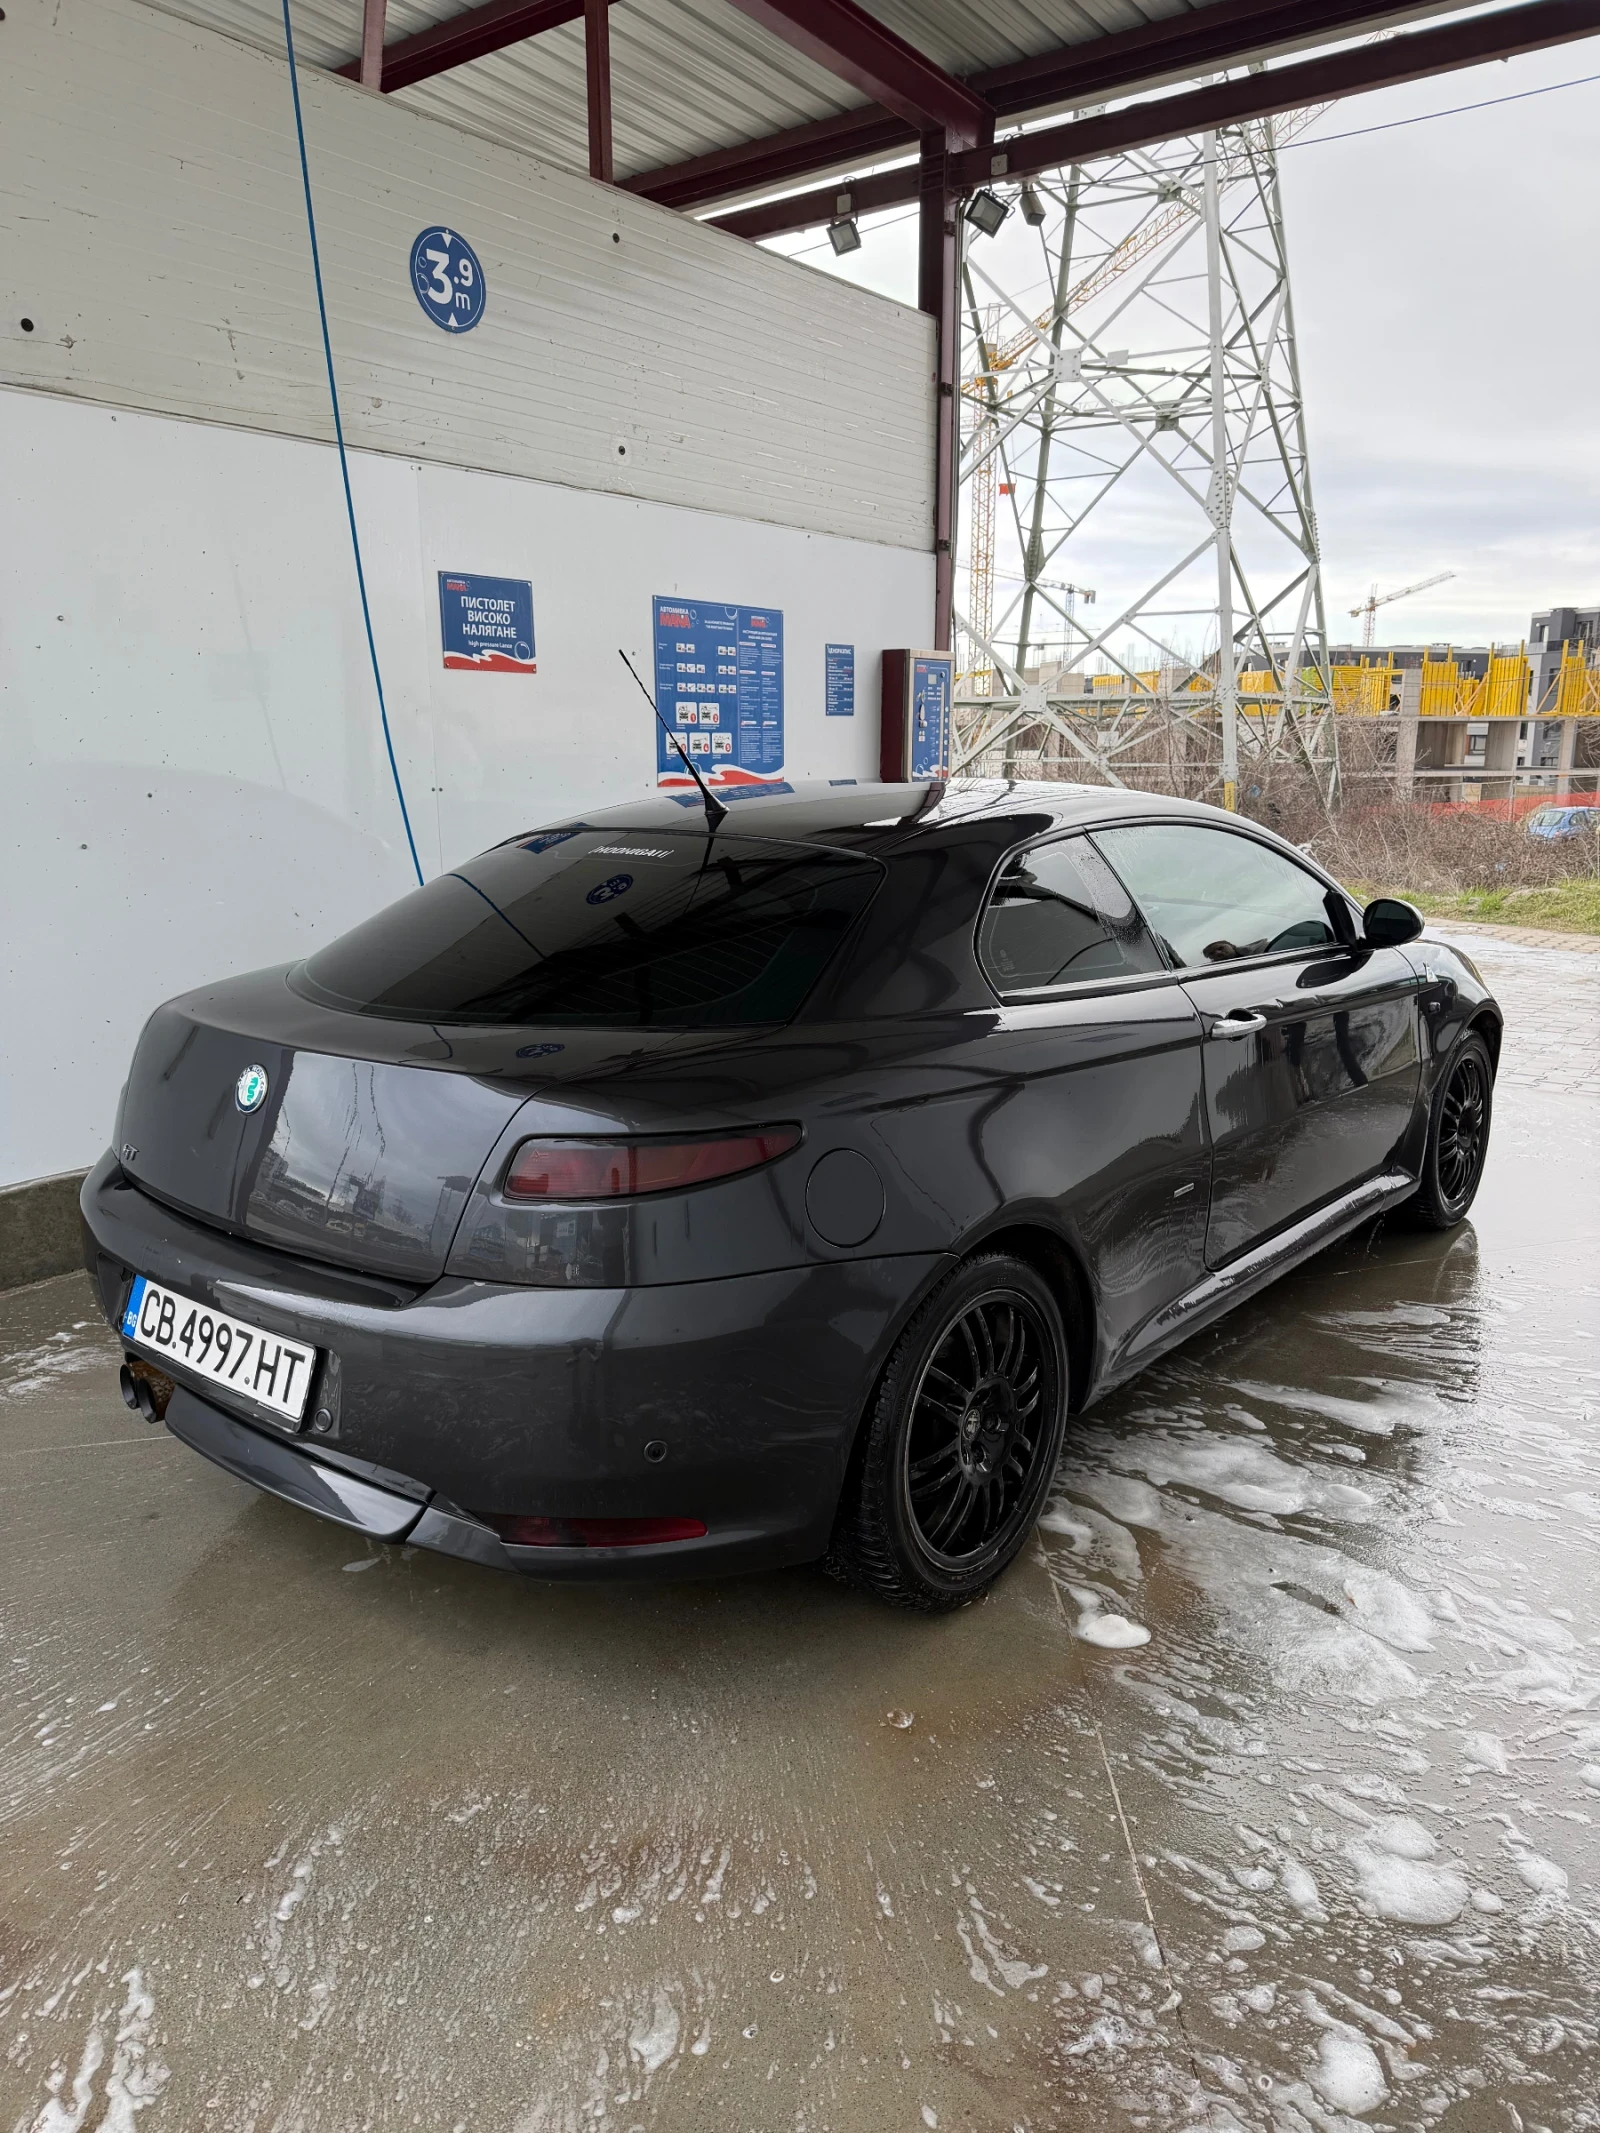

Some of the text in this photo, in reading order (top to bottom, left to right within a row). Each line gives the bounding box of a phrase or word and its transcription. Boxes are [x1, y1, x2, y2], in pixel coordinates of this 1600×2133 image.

[455, 291, 471, 311] m
[460, 595, 516, 612] ПИСТОЛЕТ
[660, 606, 689, 615] АВТОМИВКА
[467, 610, 511, 625] ВИСОКО
[462, 623, 517, 639] НАЛЯГАНЕ
[468, 640, 479, 648] high
[127, 1311, 138, 1328] BG
